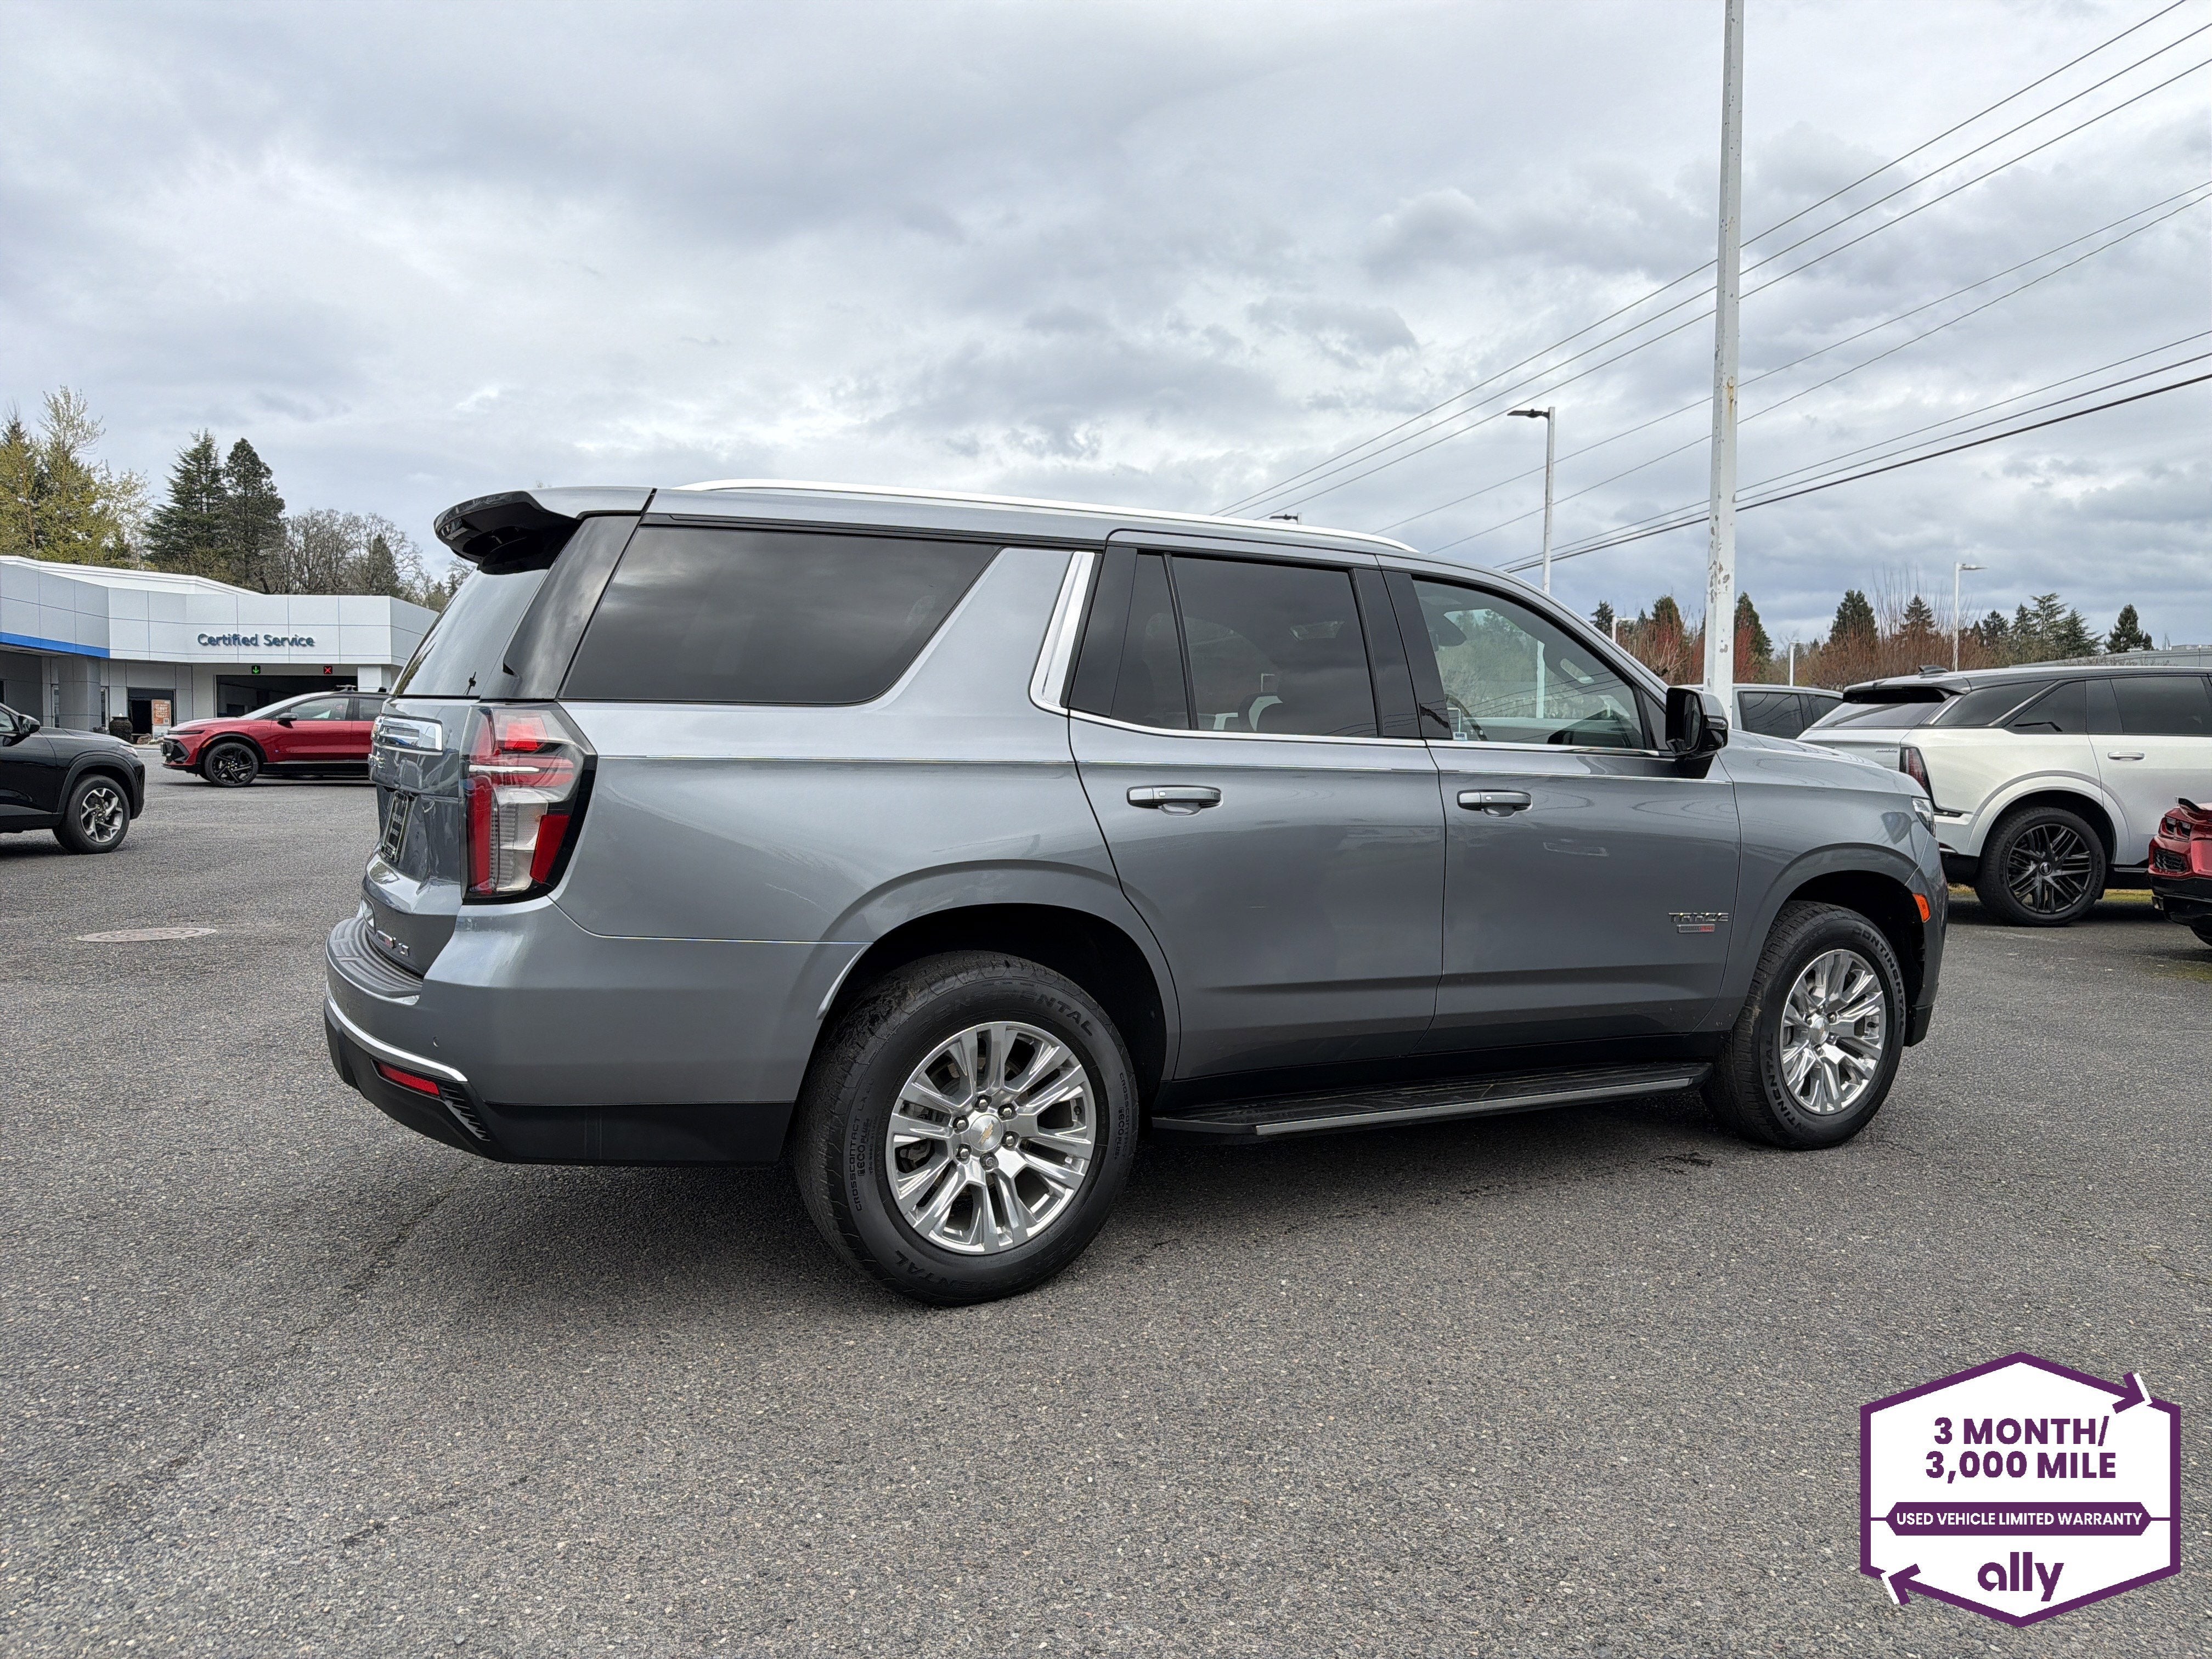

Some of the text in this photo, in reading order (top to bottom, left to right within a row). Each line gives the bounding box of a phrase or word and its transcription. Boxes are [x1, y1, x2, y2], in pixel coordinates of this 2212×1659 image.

[198, 633, 315, 646] Certified Service
[849, 1115, 863, 1211] CROSSCONTACT
